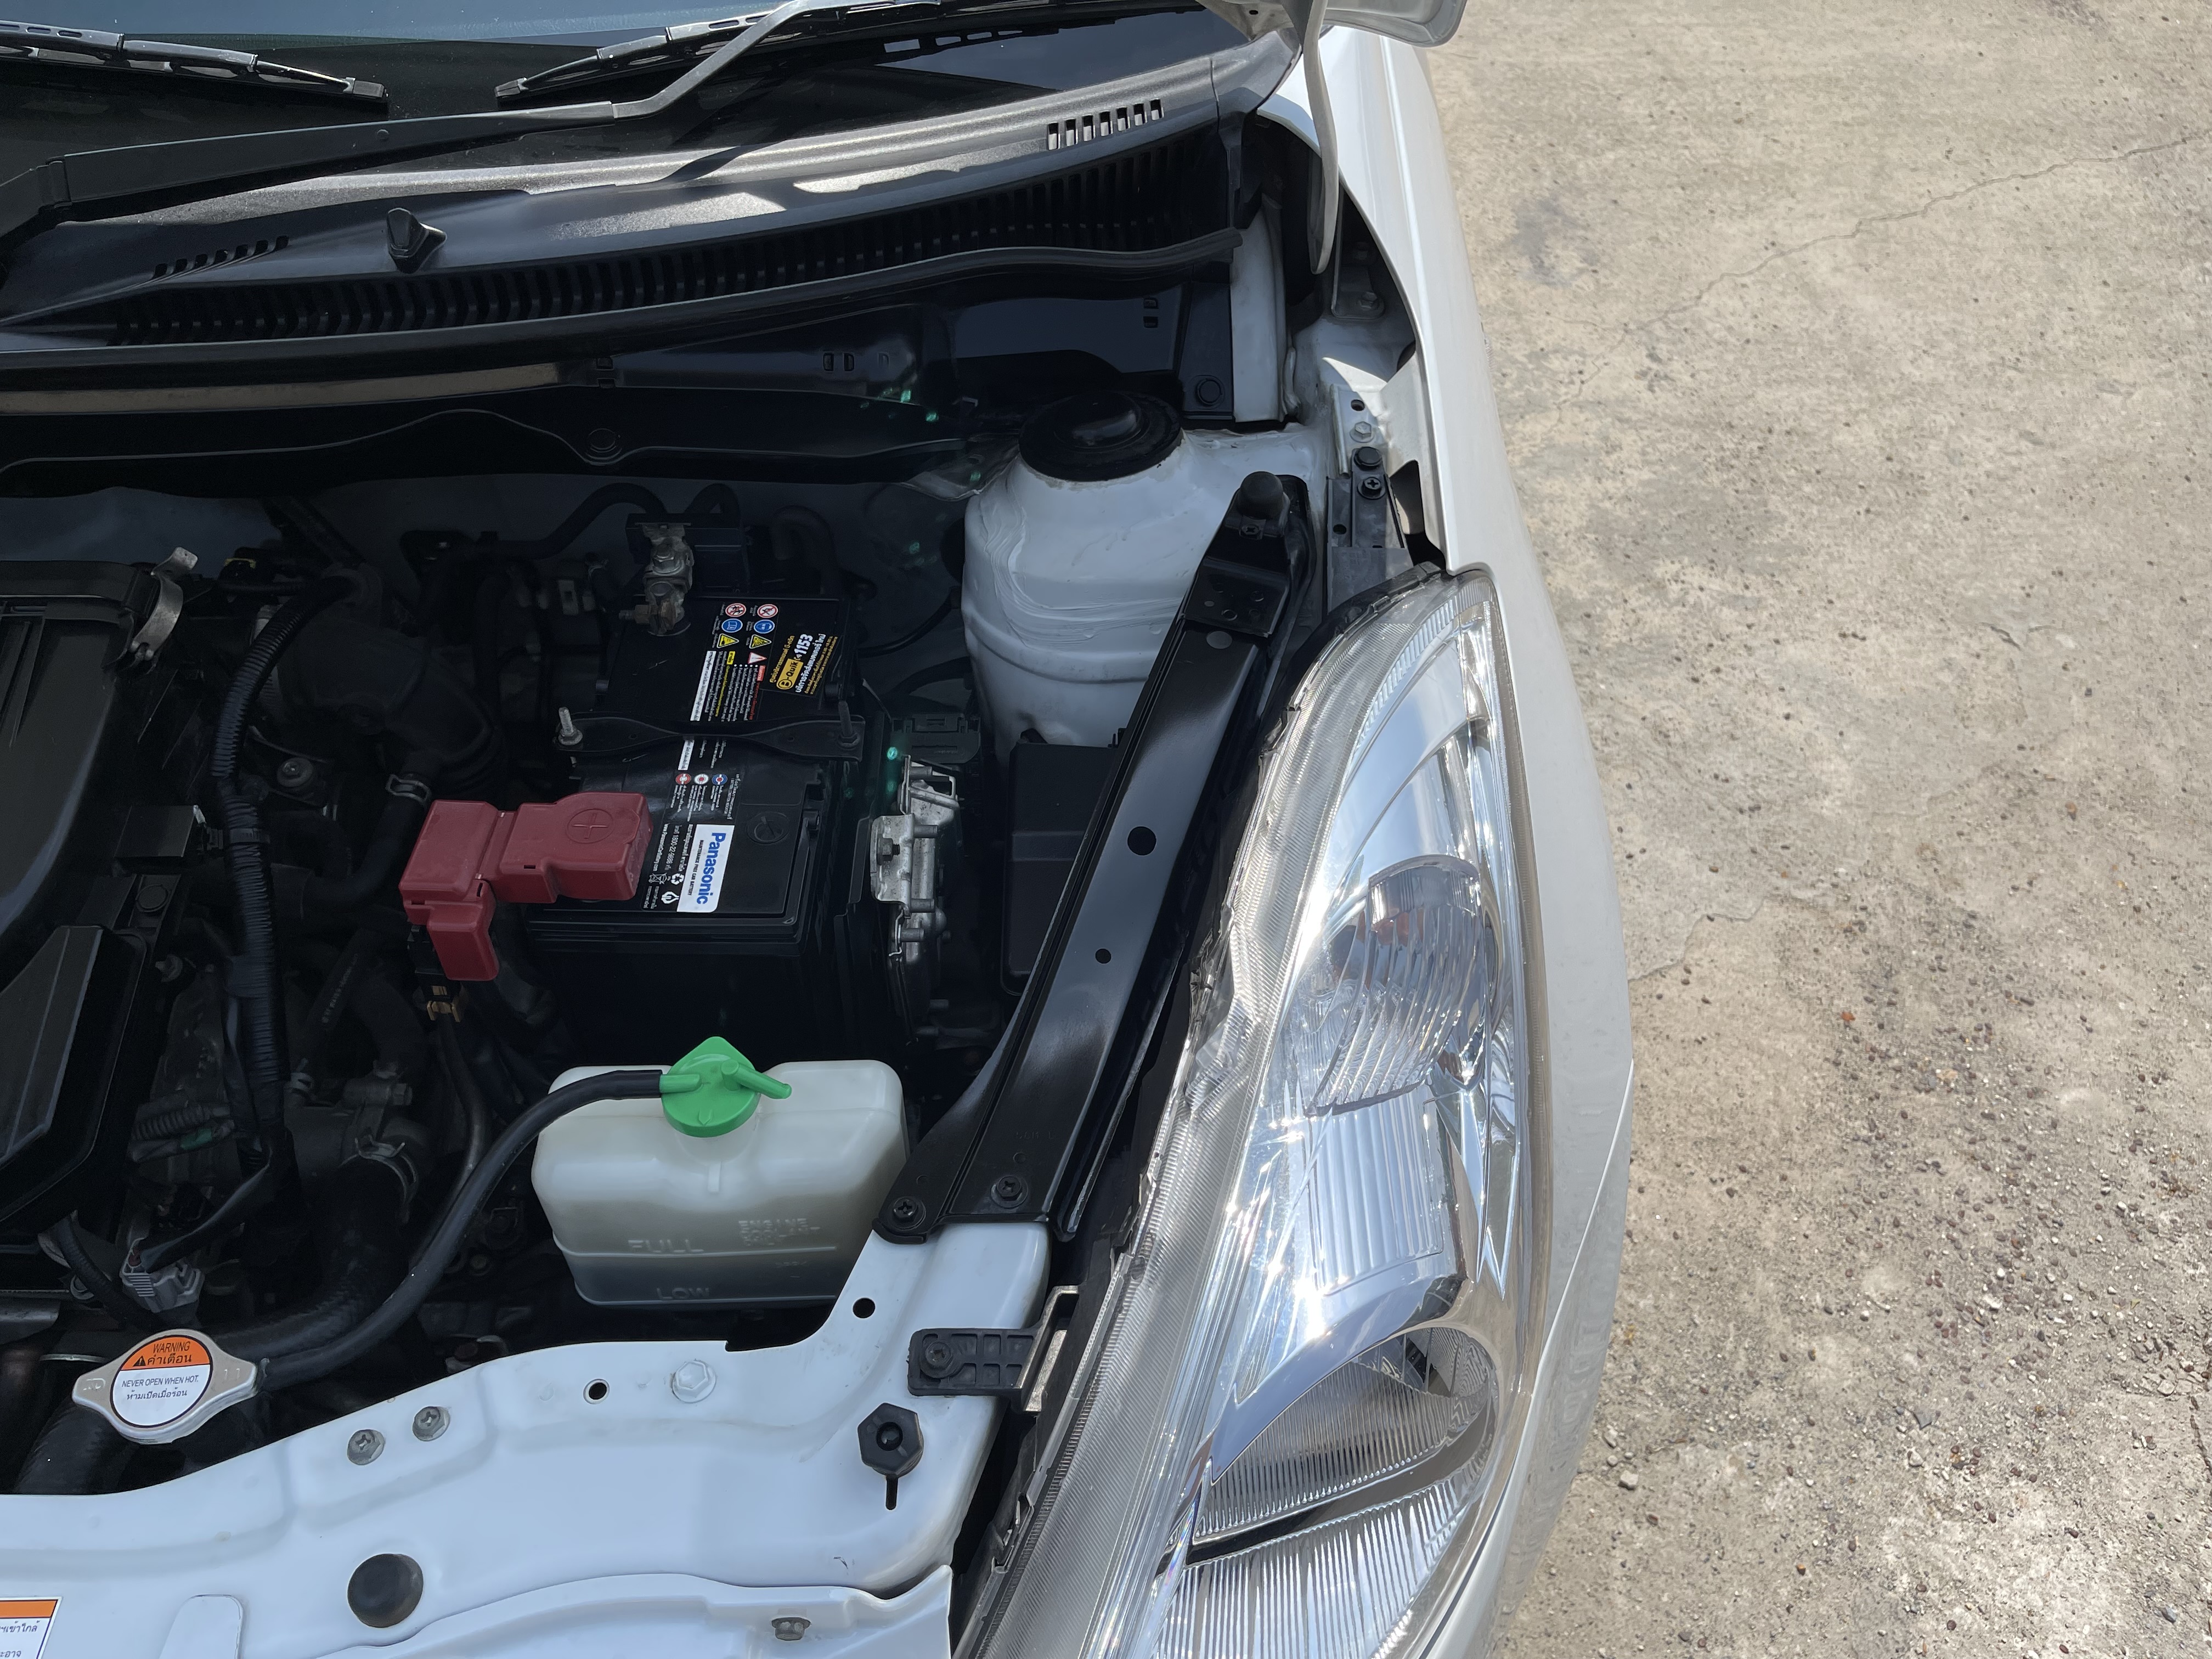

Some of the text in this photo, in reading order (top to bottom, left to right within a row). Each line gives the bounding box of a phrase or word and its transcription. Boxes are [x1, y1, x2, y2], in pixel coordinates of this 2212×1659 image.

[778, 634, 813, 688] B-Quik 1153
[697, 833, 726, 904] Panasonic
[628, 1239, 704, 1253] FULL
[657, 1288, 710, 1300] LOW
[153, 1341, 190, 1353] WARNING
[147, 1353, 191, 1365] คำเตือน
[122, 1375, 199, 1387] NEVER OPEN WHEN HOT.
[127, 1387, 188, 1400] ห้ามเปิดเมื่อร้อน
